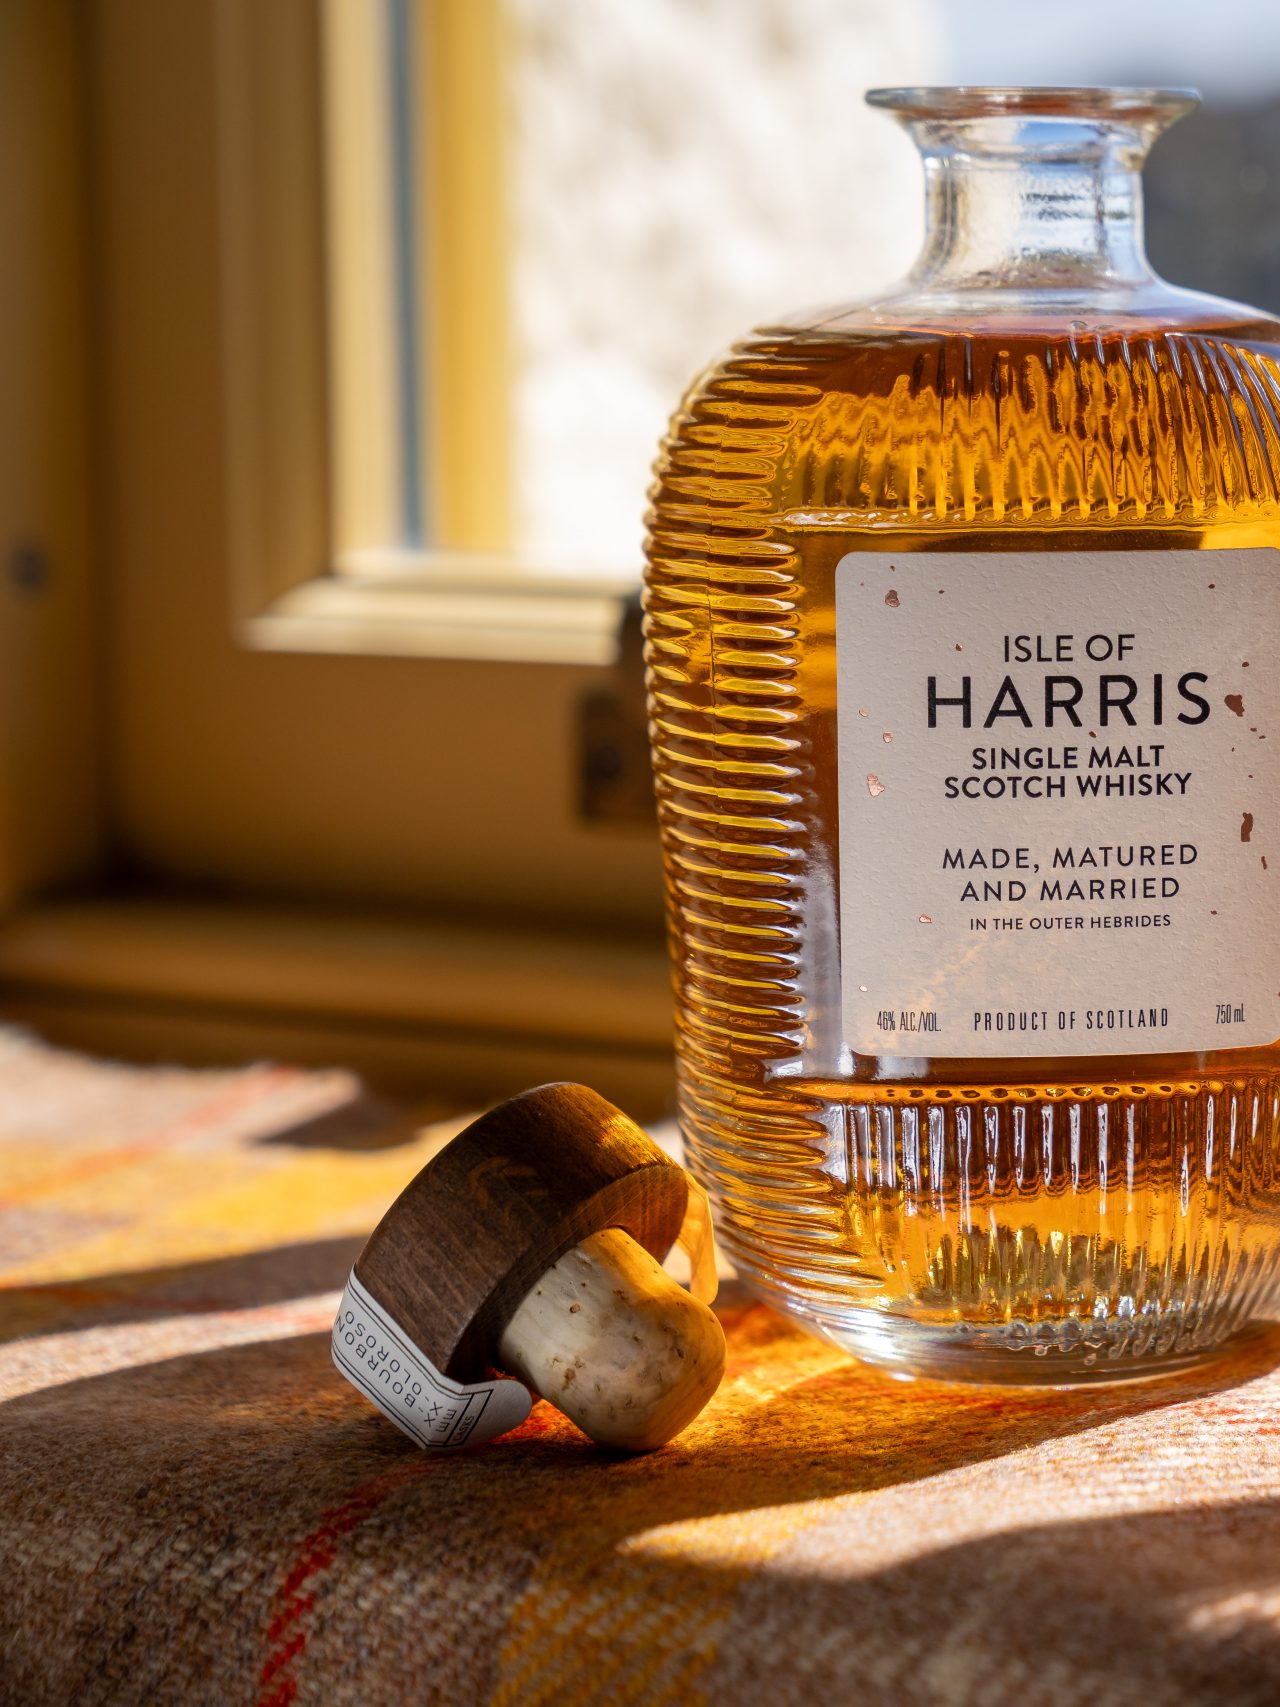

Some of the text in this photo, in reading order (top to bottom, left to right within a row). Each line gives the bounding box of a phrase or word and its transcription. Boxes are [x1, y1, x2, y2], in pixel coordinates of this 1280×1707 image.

[1003, 633, 1135, 663] ISLE OF
[927, 671, 1211, 729] HARRIS
[972, 744, 1165, 770] SINGLE MALT
[944, 772, 1192, 799] SCOTCH WHISKY
[942, 844, 1198, 874] MADE, MATURED
[960, 877, 1180, 902] AND MARRIED
[970, 914, 1171, 931] IN THE OUTER HEBRIDES
[876, 1010, 896, 1032] 46%
[974, 1008, 1169, 1032] PRODUCT OF SCOTLAND
[1215, 1002, 1246, 1024] 750 mL
[335, 1315, 451, 1433] EX-BOURBON
[345, 1310, 458, 1420] EX-OLOROSO
